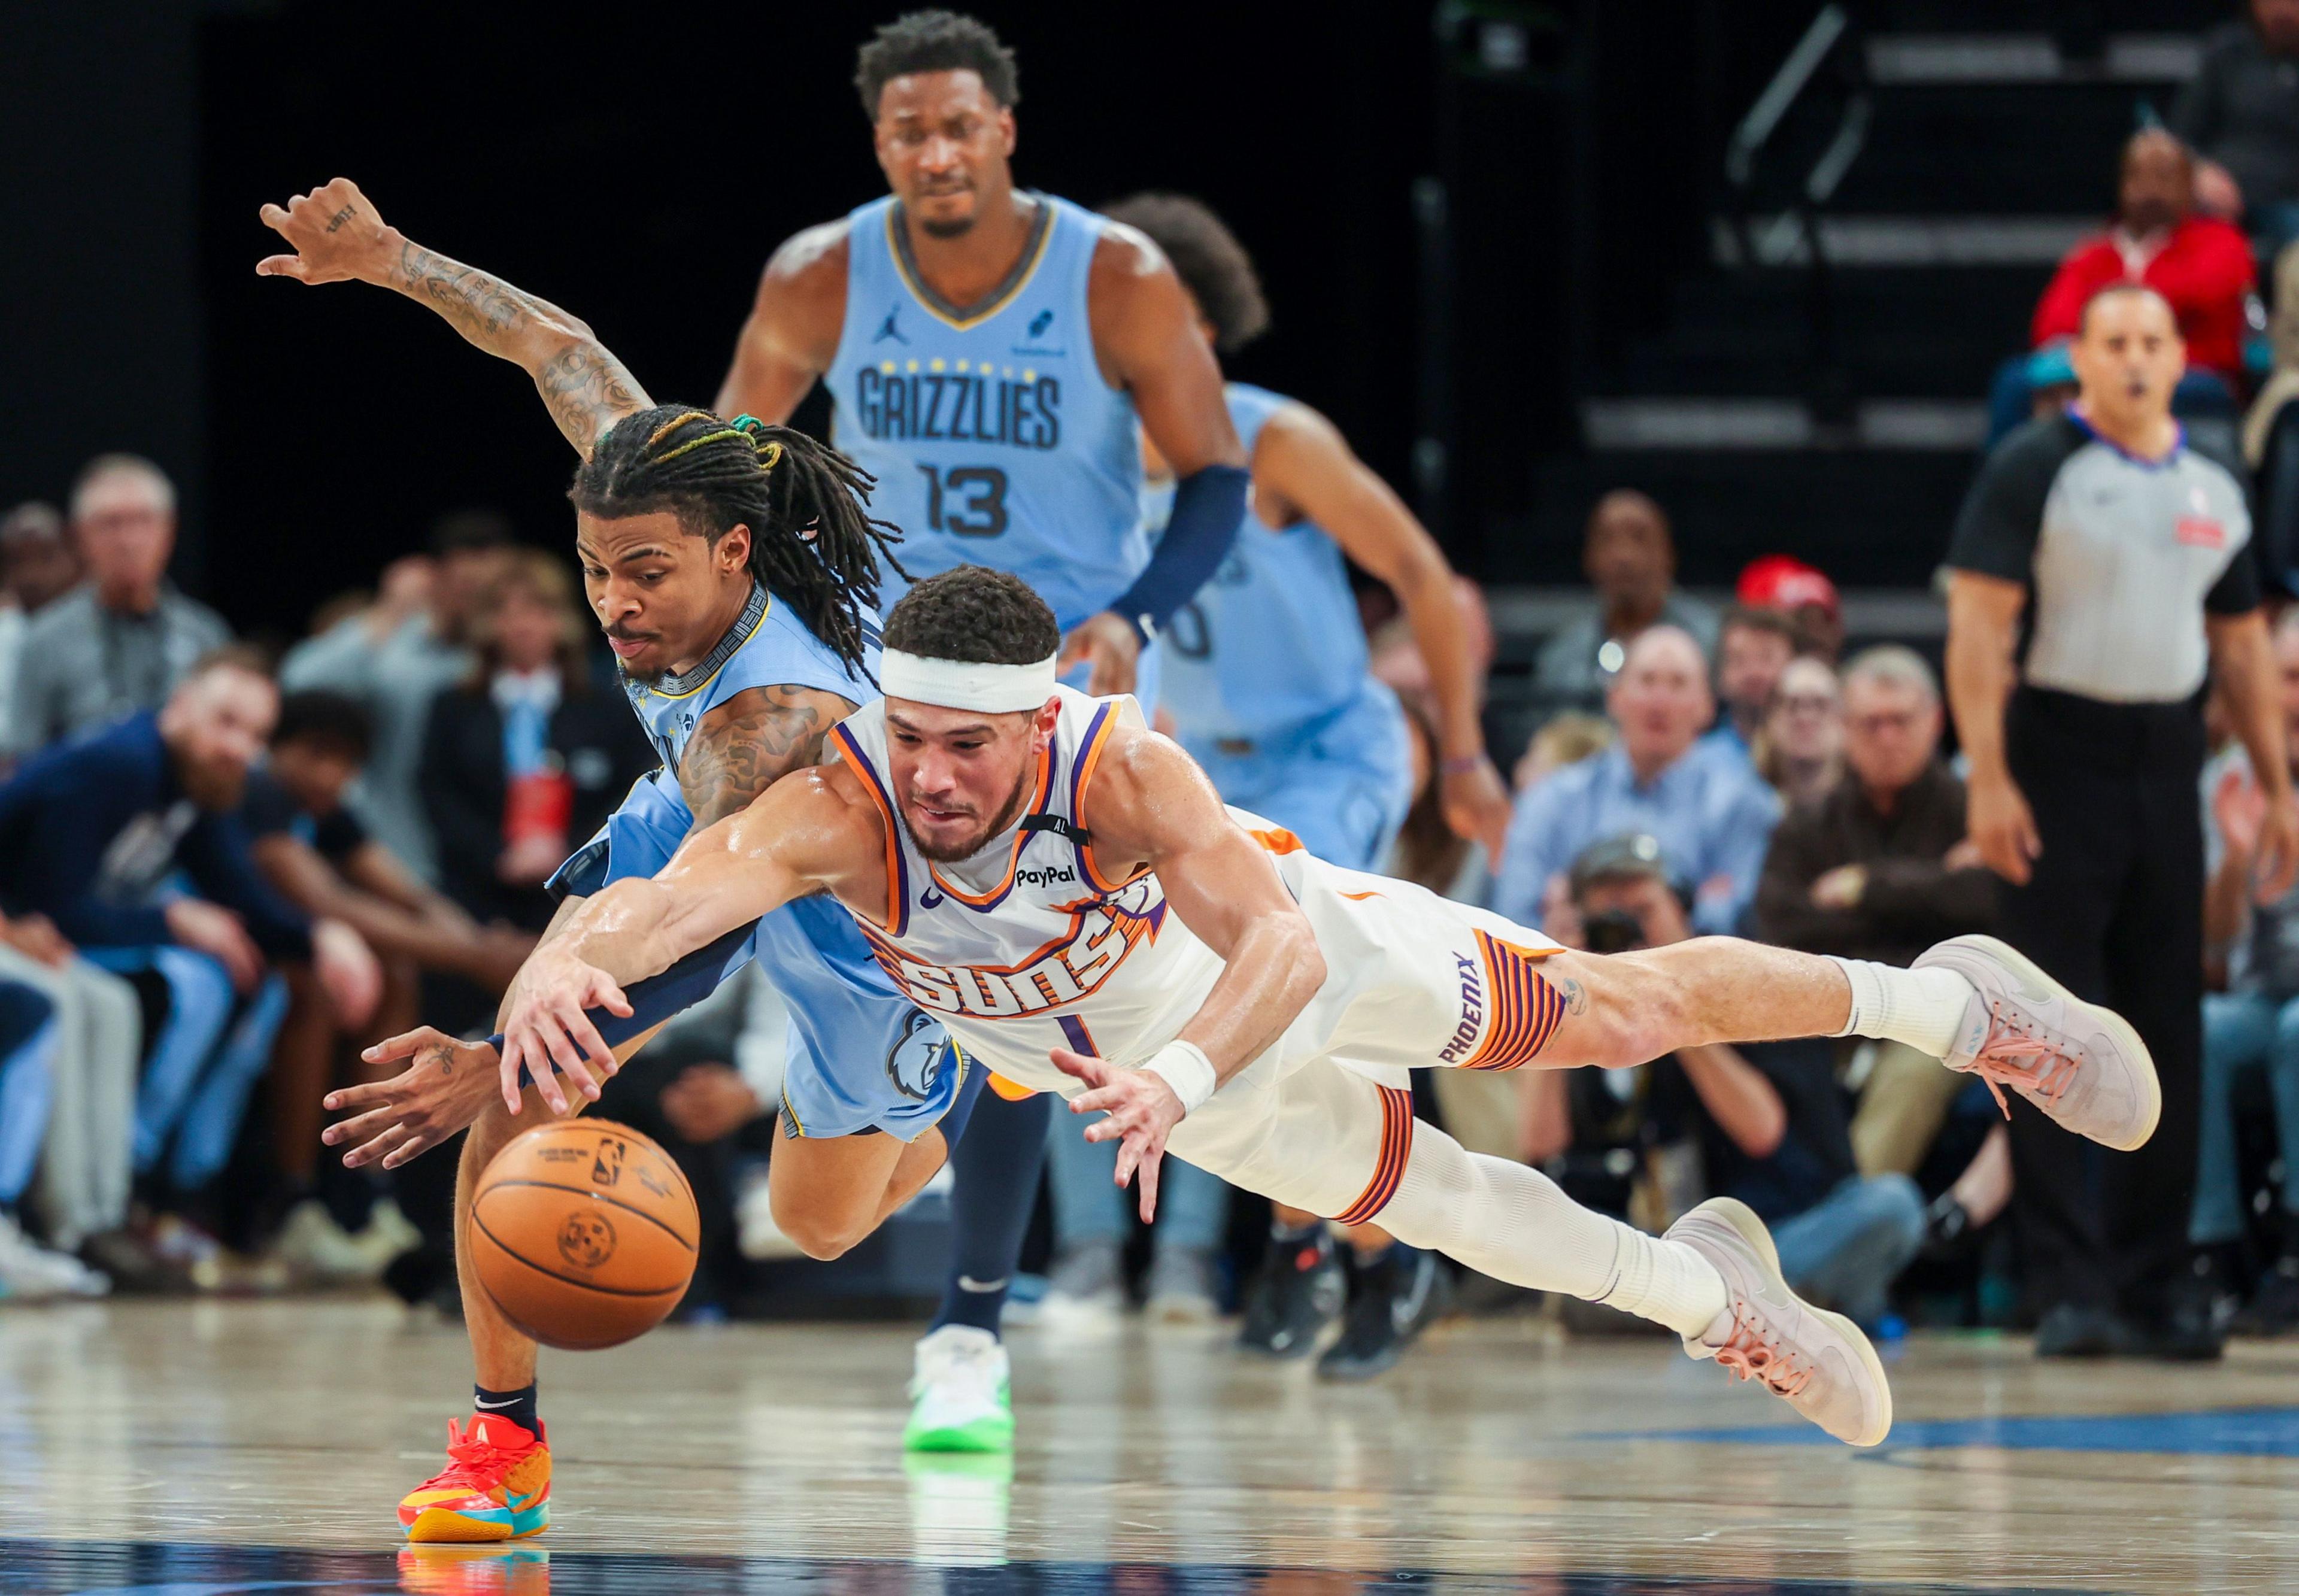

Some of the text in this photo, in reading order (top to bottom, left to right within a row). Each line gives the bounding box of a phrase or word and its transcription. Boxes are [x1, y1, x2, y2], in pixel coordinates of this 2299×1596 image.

[858, 366, 1060, 450] GRIZZLIES
[917, 463, 1009, 537] 13
[1054, 818, 1065, 834] AL
[1017, 865, 1076, 888] PayPal
[1438, 951, 1482, 1063] PHOENIX
